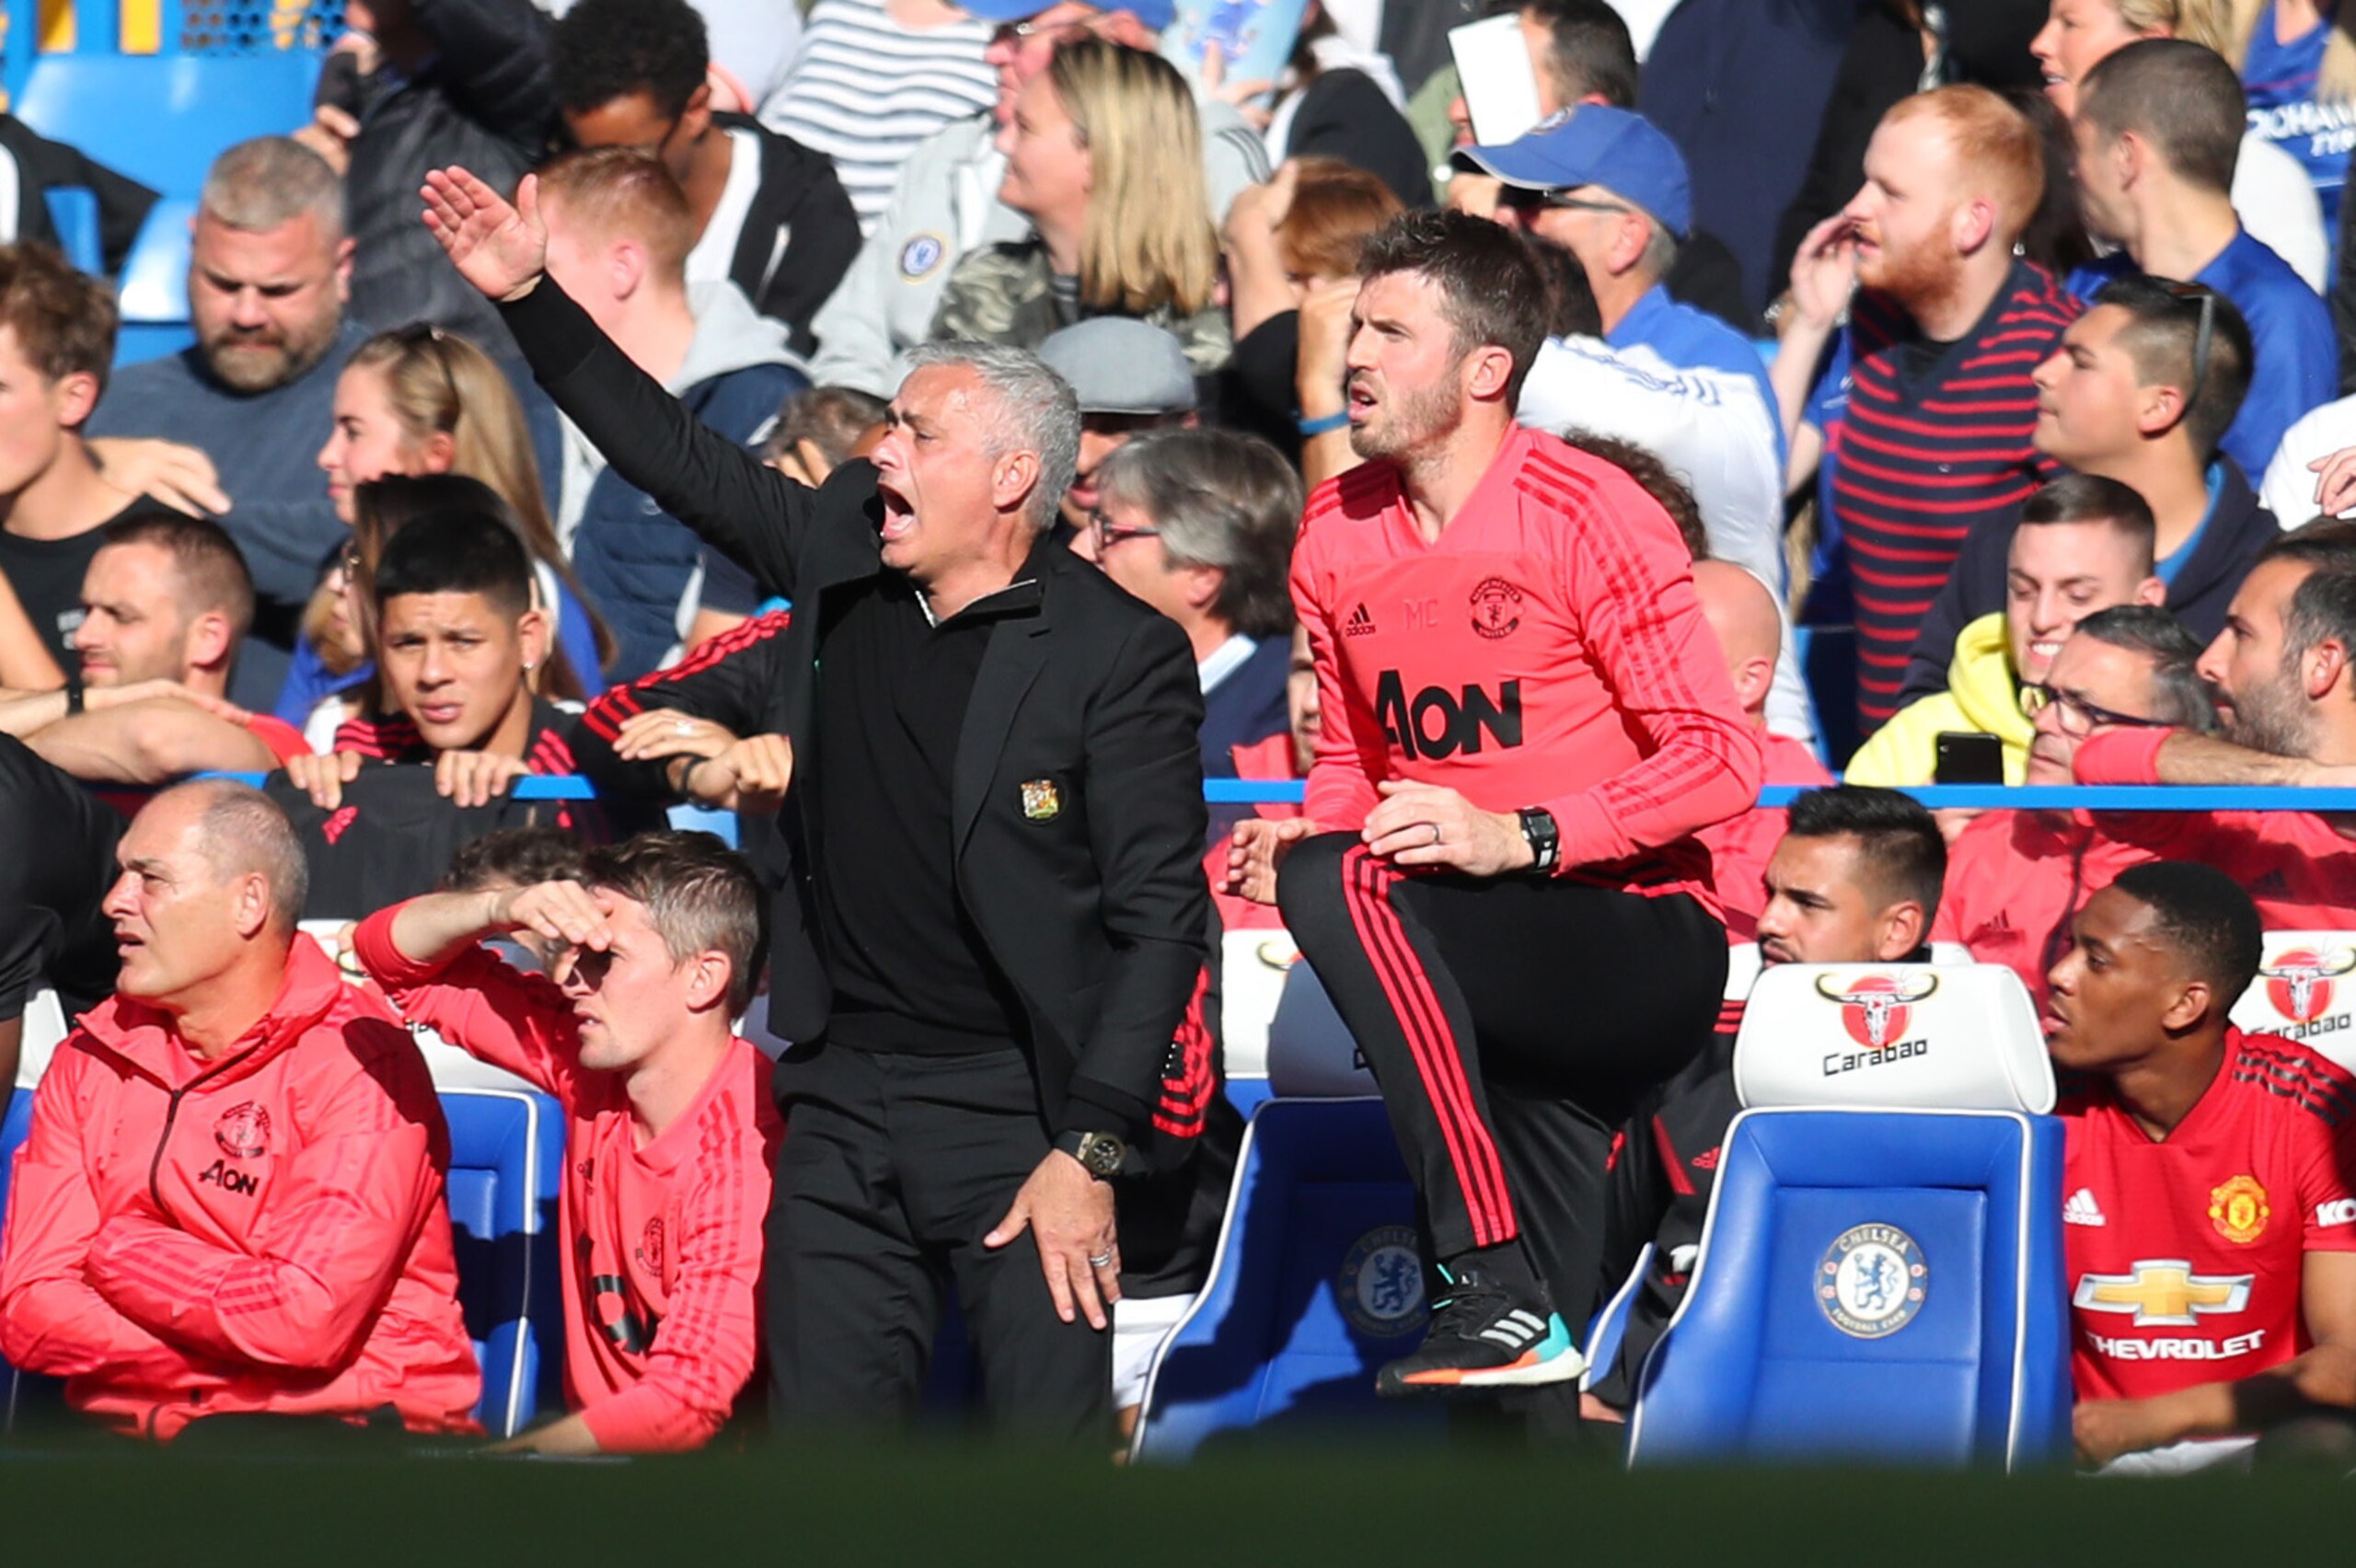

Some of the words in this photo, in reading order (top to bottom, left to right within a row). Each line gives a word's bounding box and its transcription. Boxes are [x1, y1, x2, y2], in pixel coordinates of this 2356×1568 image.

[1824, 1038, 1928, 1077] Carabao
[199, 1159, 260, 1198] AON
[1840, 1228, 1909, 1255] CHELSEA
